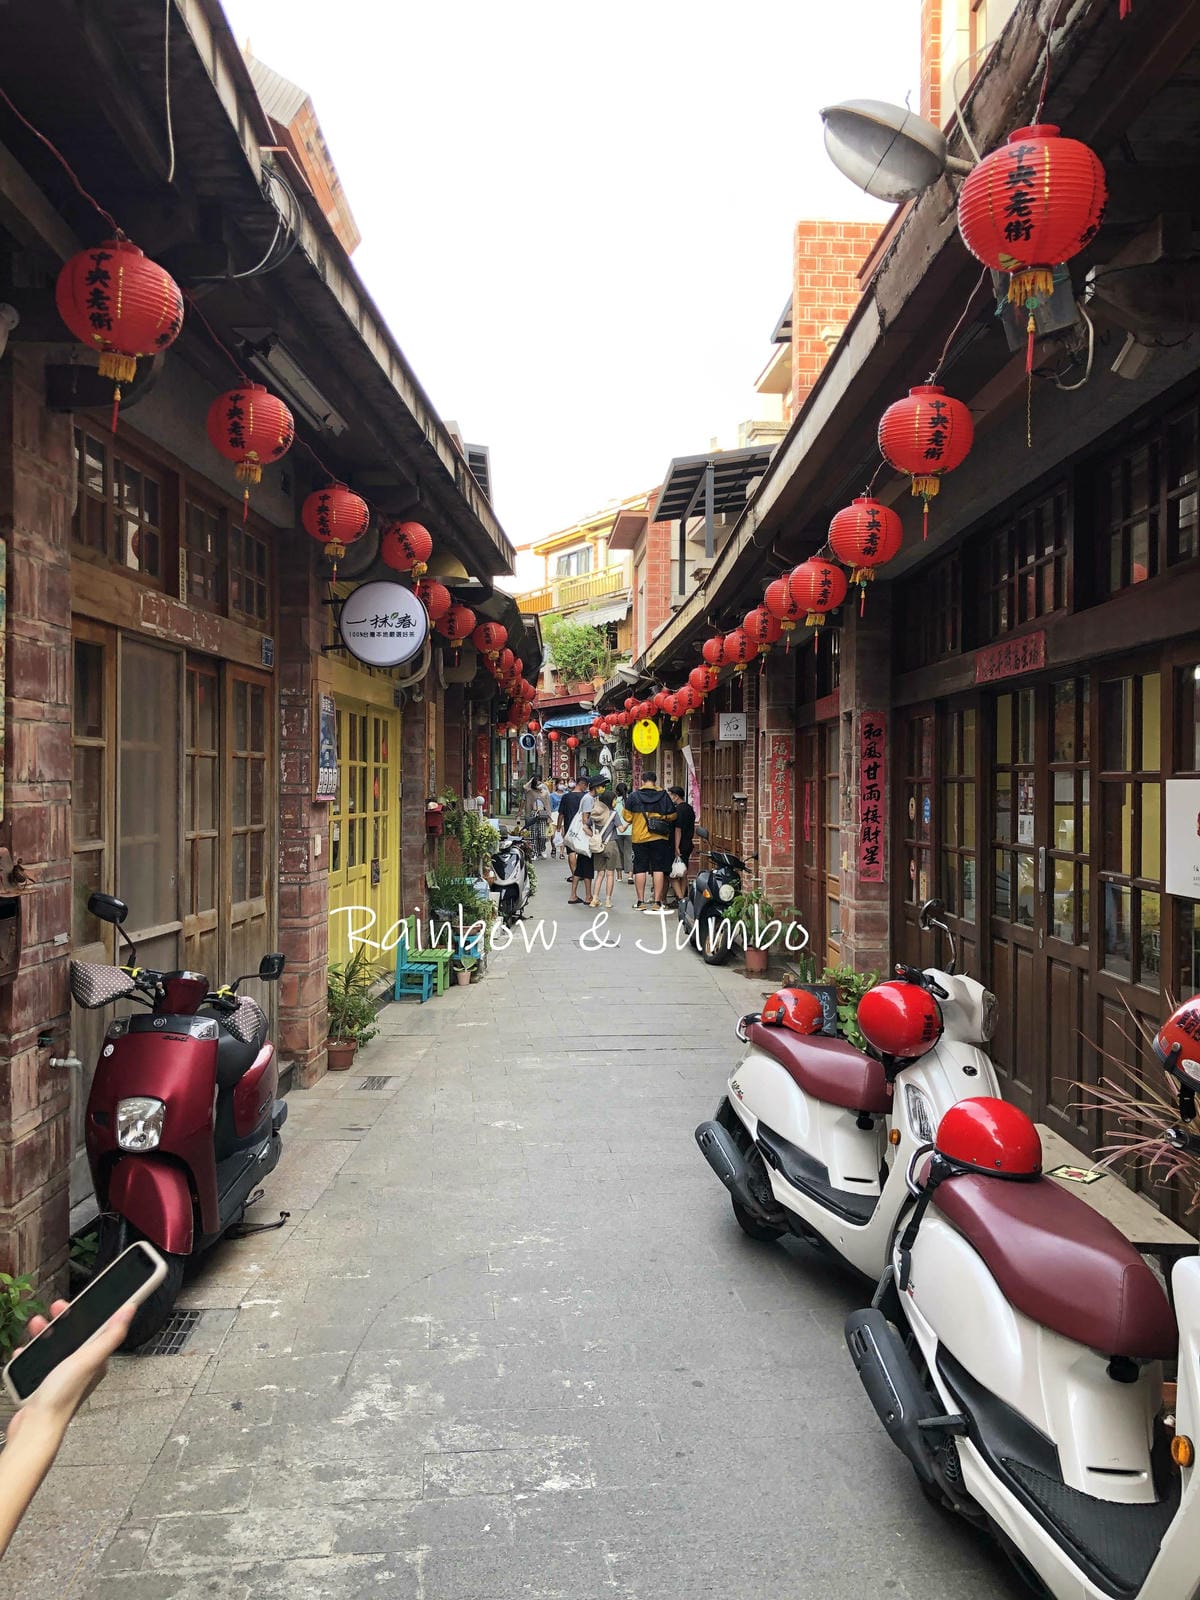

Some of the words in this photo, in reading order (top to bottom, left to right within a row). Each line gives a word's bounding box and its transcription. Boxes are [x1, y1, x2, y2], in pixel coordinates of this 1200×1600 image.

[1004, 145, 1036, 242] 中央老街
[86, 252, 113, 331] 中央老街
[227, 393, 244, 448] 中央老街
[924, 400, 948, 460] 中央老街
[317, 494, 331, 536] 中央老街
[862, 509, 881, 556] 中央老街
[394, 528, 416, 559] 中央老街
[816, 569, 832, 605] 中央老街
[346, 614, 417, 629] 一抹春
[863, 723, 883, 865] 和風甘雨接財星
